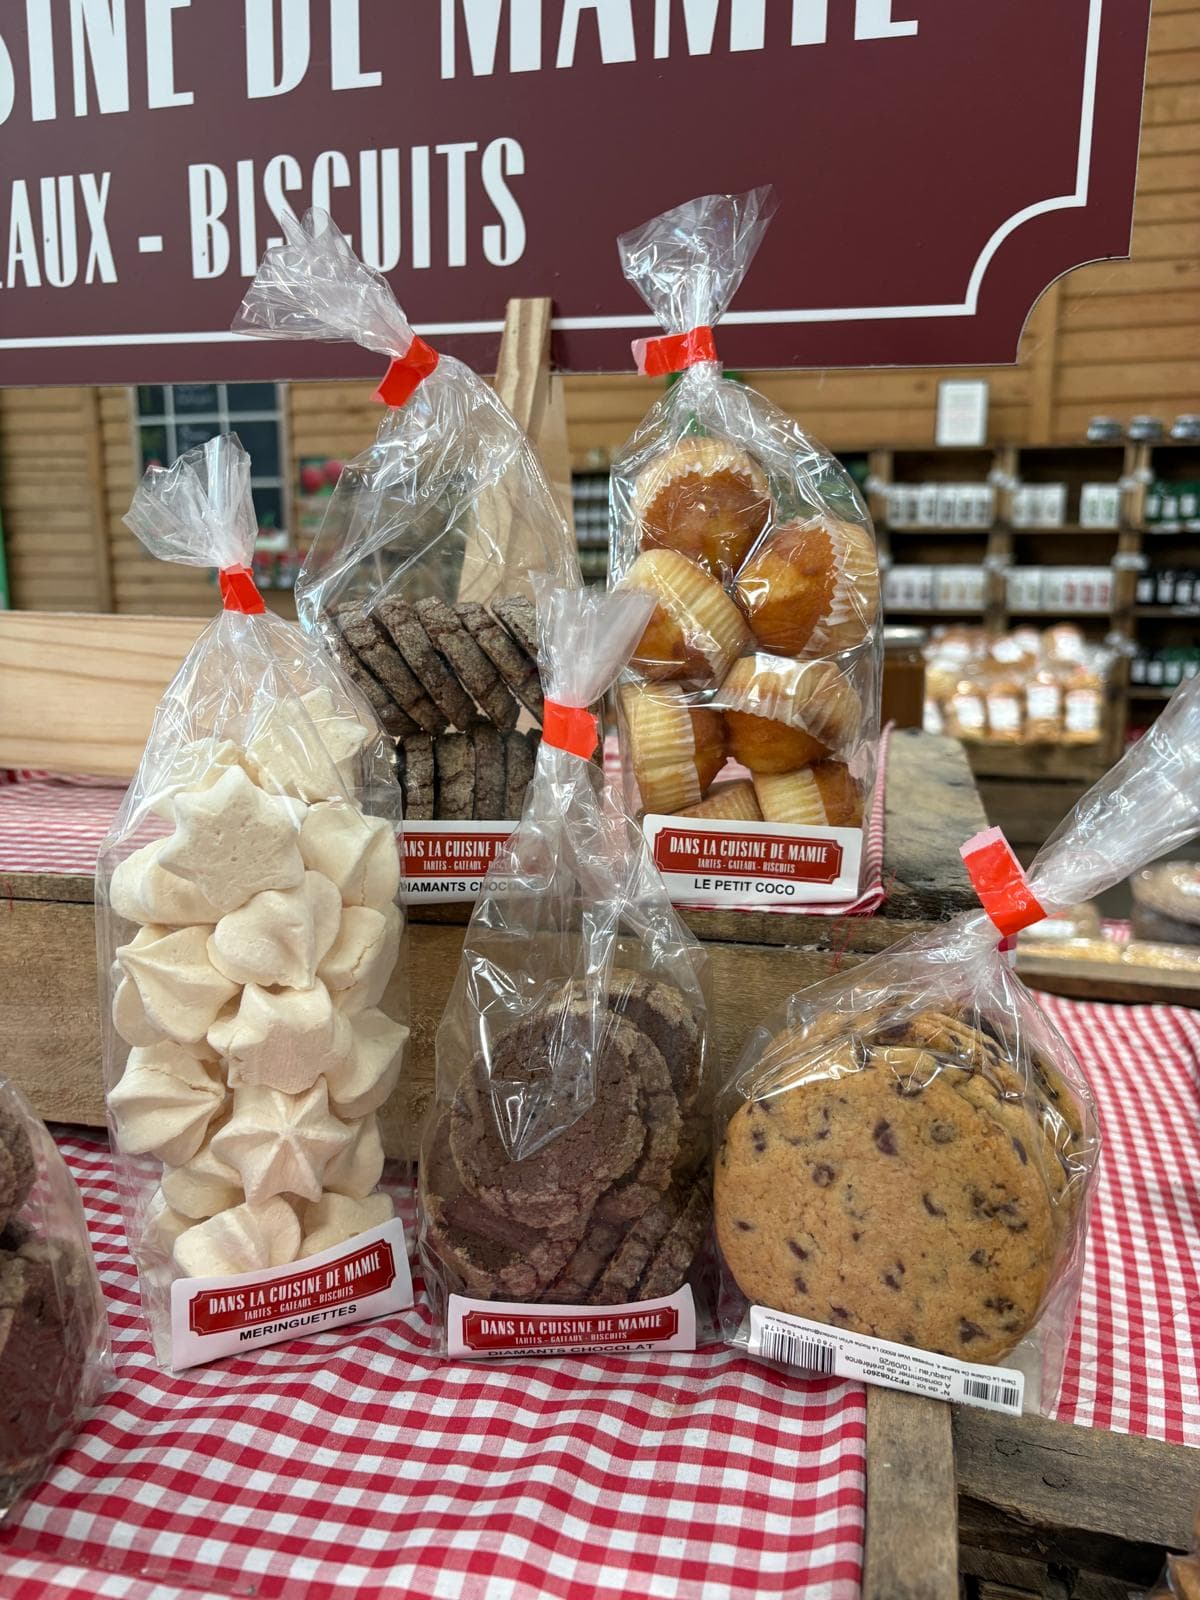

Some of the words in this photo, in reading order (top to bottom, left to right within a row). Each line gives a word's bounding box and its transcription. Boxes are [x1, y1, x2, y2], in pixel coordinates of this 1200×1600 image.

[0, 172, 118, 288] AUX
[188, 137, 527, 280] BISCUITS
[403, 840, 425, 857] ANS
[428, 840, 442, 857] LA
[445, 840, 491, 857] CUISINE
[669, 836, 700, 855] DANS
[703, 839, 717, 856] LA
[720, 839, 766, 859] CUISINE
[770, 843, 785, 860] DE
[787, 844, 829, 864] MAMIE
[423, 861, 447, 871] TARTES
[697, 858, 721, 869] TARTES
[762, 862, 796, 874] BISCUITS
[694, 879, 711, 889] LE
[714, 880, 752, 892] PETIT
[755, 882, 795, 896] COCO
[209, 1294, 245, 1315] DANS
[250, 1290, 265, 1308] LA
[269, 1277, 321, 1303] CUISINE
[326, 1270, 341, 1288] DE
[344, 1251, 381, 1283] MAMIE
[244, 1308, 272, 1321] TARTES
[319, 1286, 354, 1305] BISCUITS
[239, 1304, 357, 1341] MERINGUETTES
[480, 1319, 515, 1336] DANS
[519, 1320, 535, 1336] LA
[539, 1319, 592, 1335] CUISINE
[597, 1319, 613, 1332] DE
[618, 1314, 662, 1331] MAMIE
[488, 1347, 566, 1357] DIAMANTS
[569, 1343, 655, 1353] CHOCOLAT
